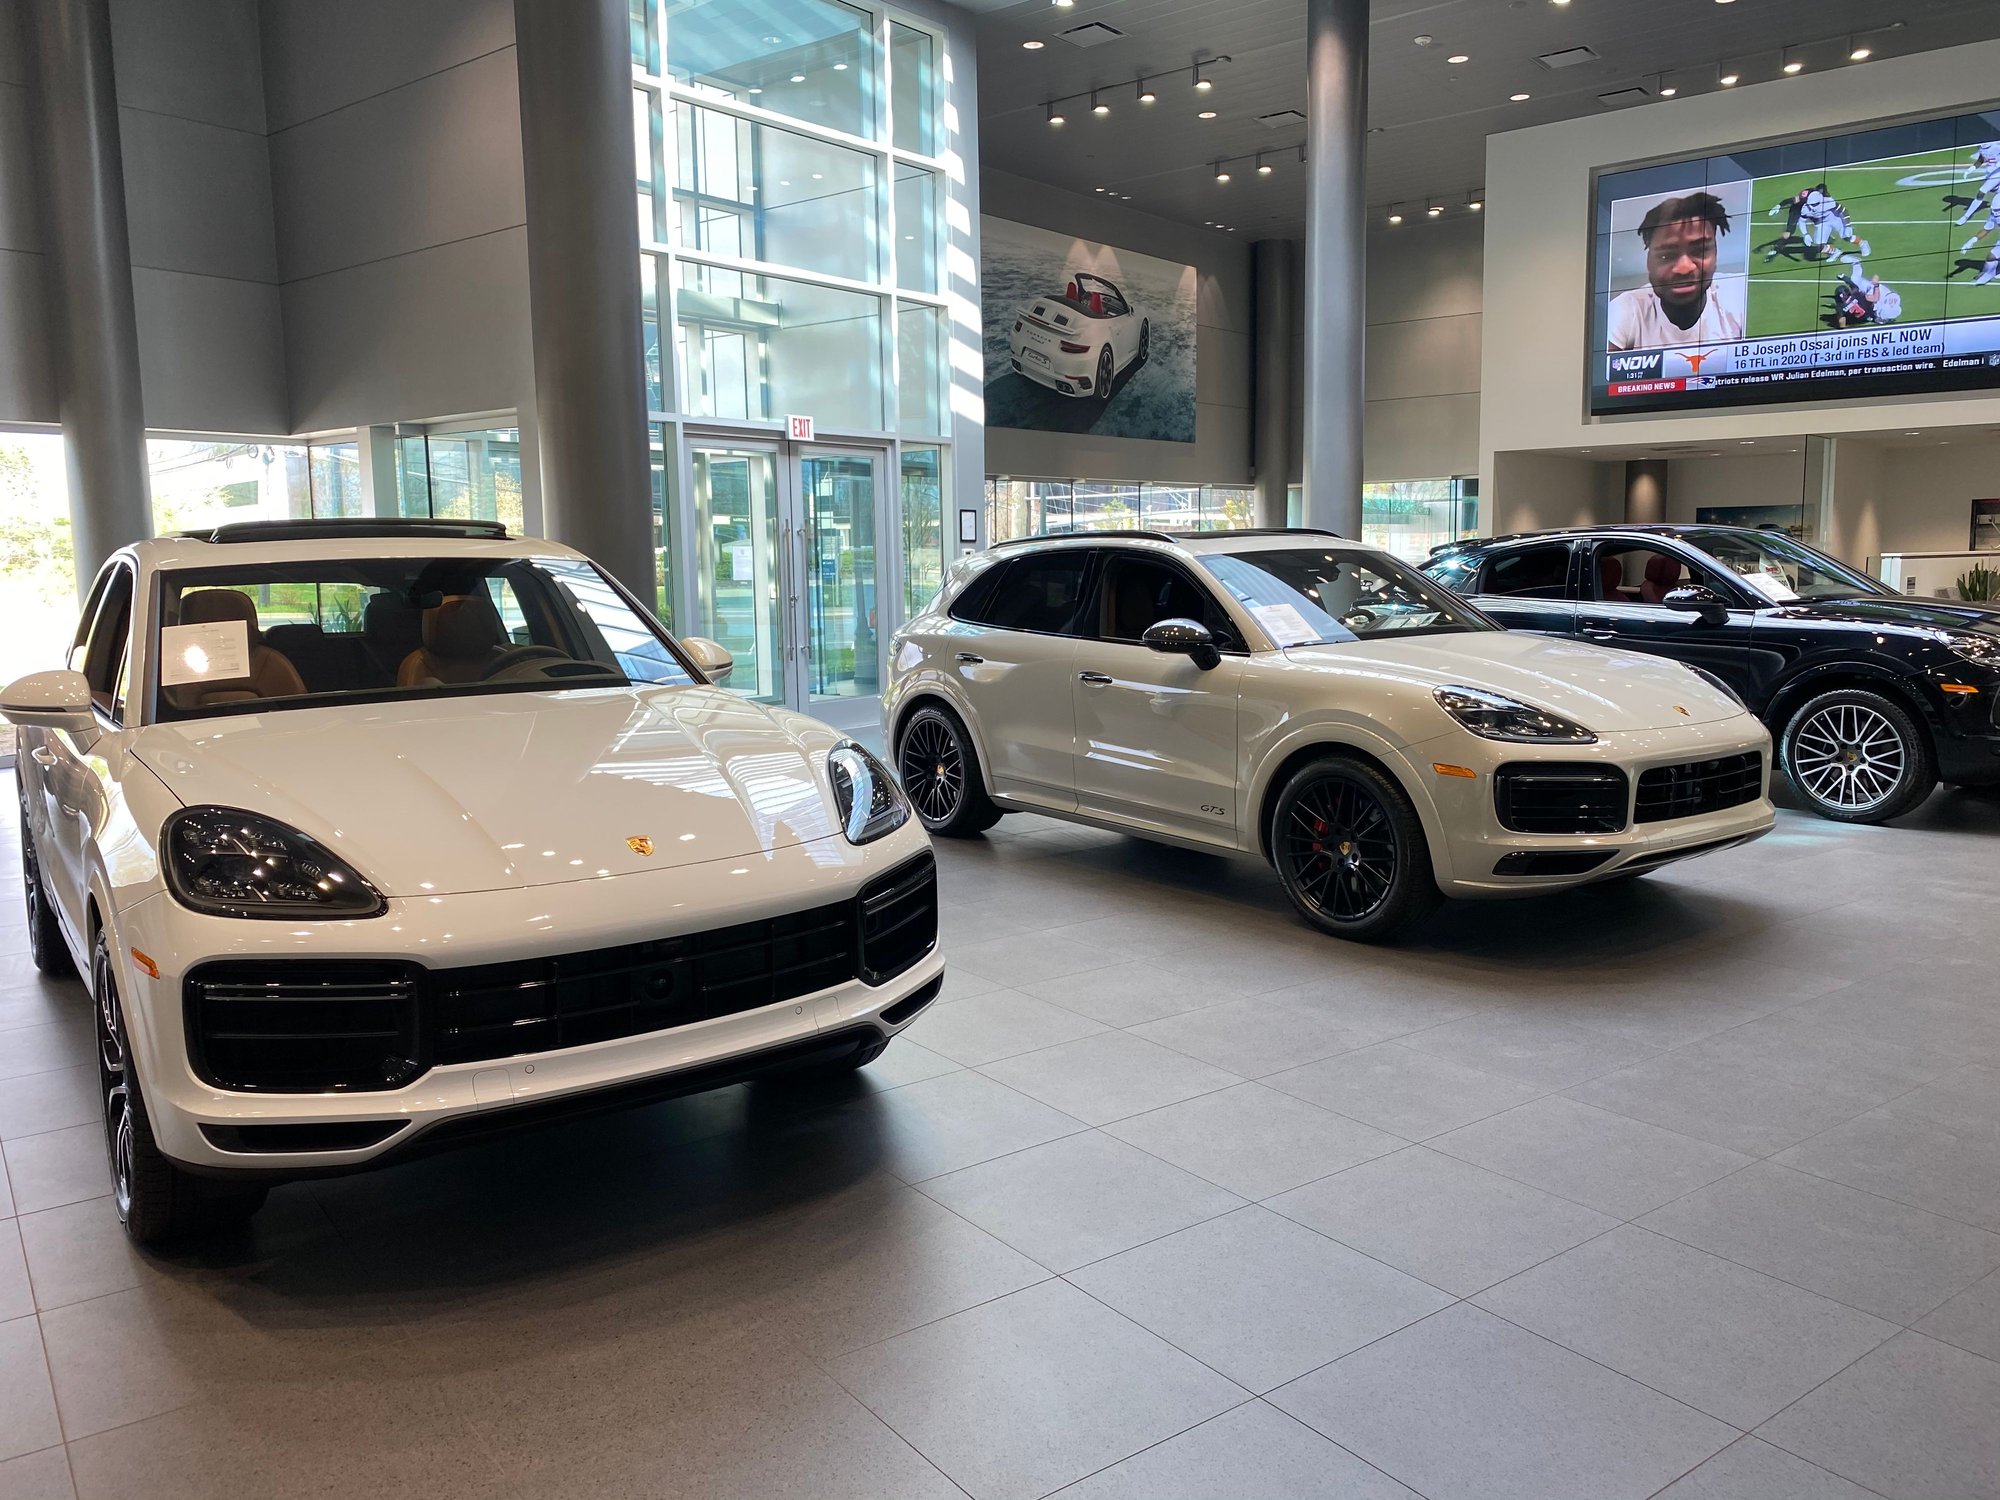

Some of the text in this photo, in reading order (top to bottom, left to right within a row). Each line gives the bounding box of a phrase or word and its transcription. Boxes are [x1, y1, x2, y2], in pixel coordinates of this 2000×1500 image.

[1734, 328, 1932, 357] LB Joseph Ossai joins NFL NOW
[1617, 354, 1660, 371] NOW
[1734, 342, 1945, 370] 16 TFL in 2020 (T-3rd in FBS & led team)
[1741, 374, 1769, 383] release
[1771, 372, 1784, 381] WR
[1785, 371, 1809, 380] Julian
[1848, 368, 1863, 376] per
[1864, 364, 1913, 374] transaction
[1942, 358, 1980, 368] Edelman
[1617, 382, 1676, 393] BREAKING NEWS
[792, 417, 811, 438] EXIT
[1200, 804, 1225, 815] GTS
